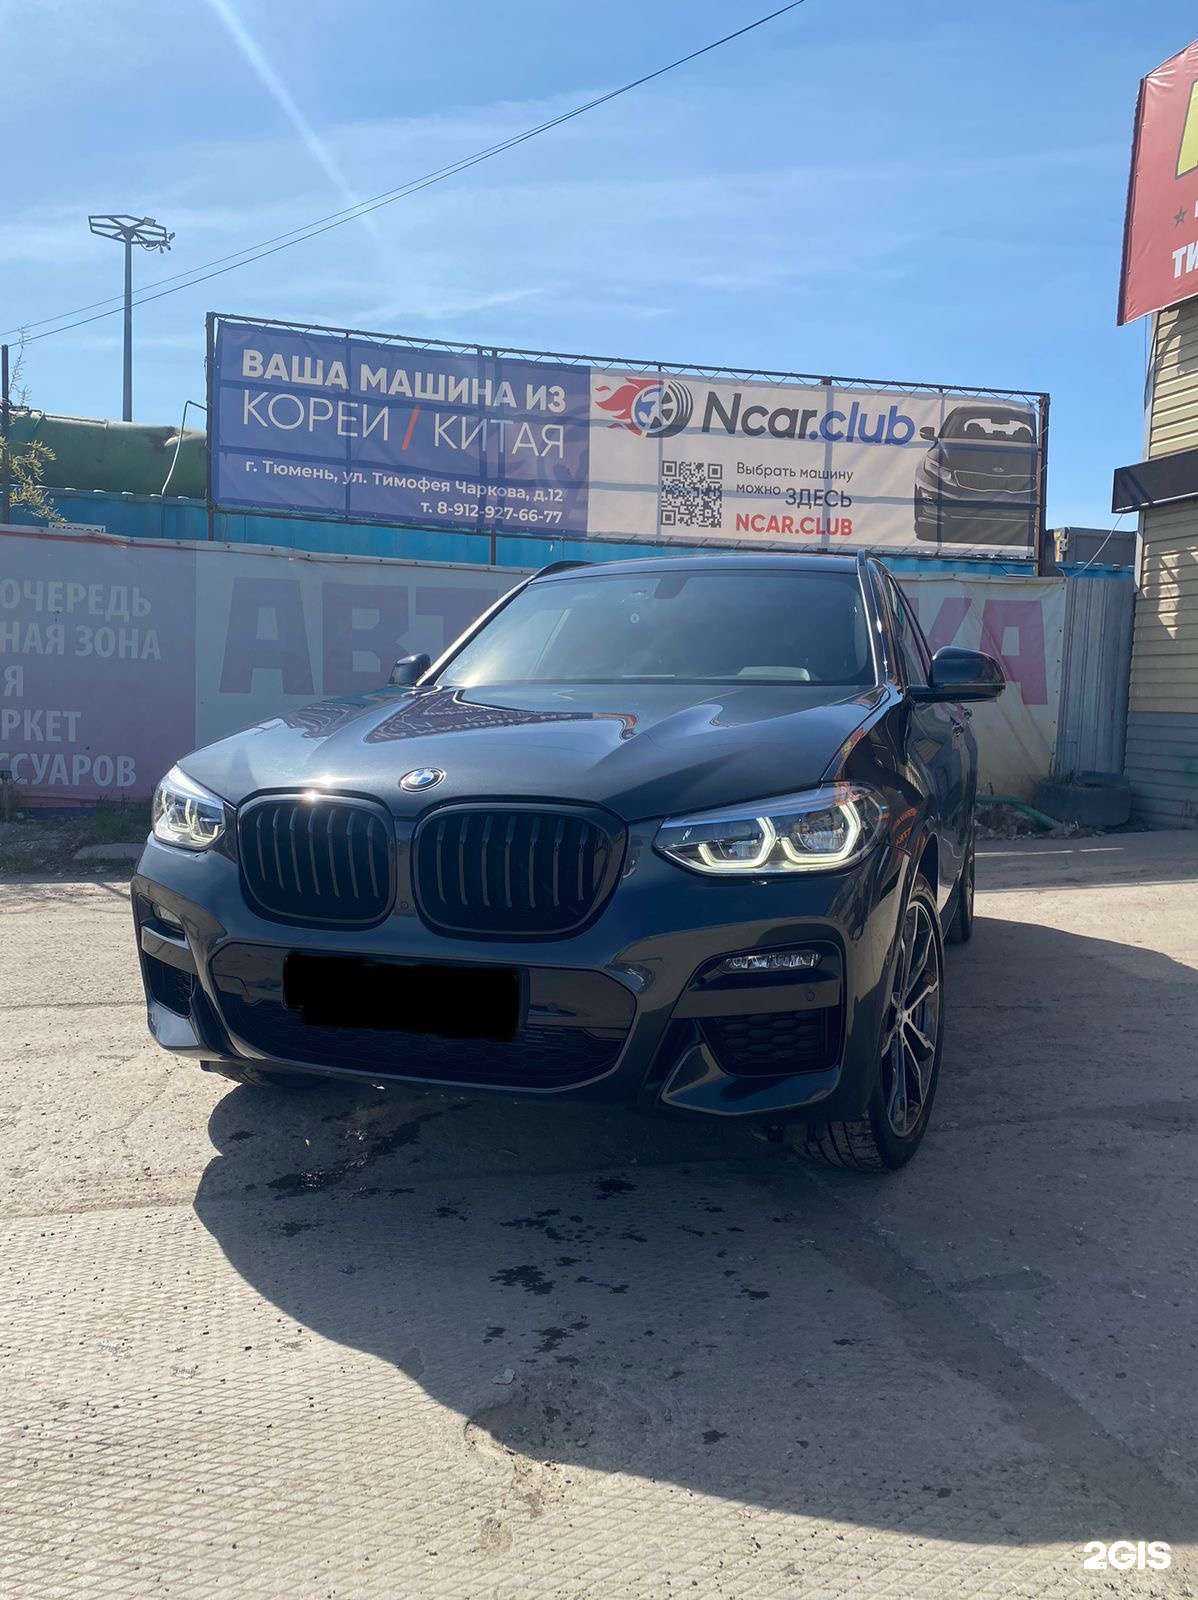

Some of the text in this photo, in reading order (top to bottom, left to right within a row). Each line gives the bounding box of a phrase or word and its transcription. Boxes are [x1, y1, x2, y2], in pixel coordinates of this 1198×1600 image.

[242, 349, 567, 413] ВАША МАШИНА ИЗ
[243, 389, 389, 441] КОРЕИ
[433, 412, 564, 459] КИТАЯ
[701, 391, 916, 446] Ncar.club
[245, 460, 564, 502] г. Тюмень, ул. Тимофея Чаркова, д.12
[736, 462, 854, 484] Выбрать машину
[420, 501, 563, 523] т. 8-912-927-66-77
[736, 484, 853, 510] можно ЗДЕСЬ
[735, 513, 853, 536] NCAR.CLUB
[0, 578, 152, 622] ОЧЕРЕДЬ
[74, 624, 161, 660] ЗОНА
